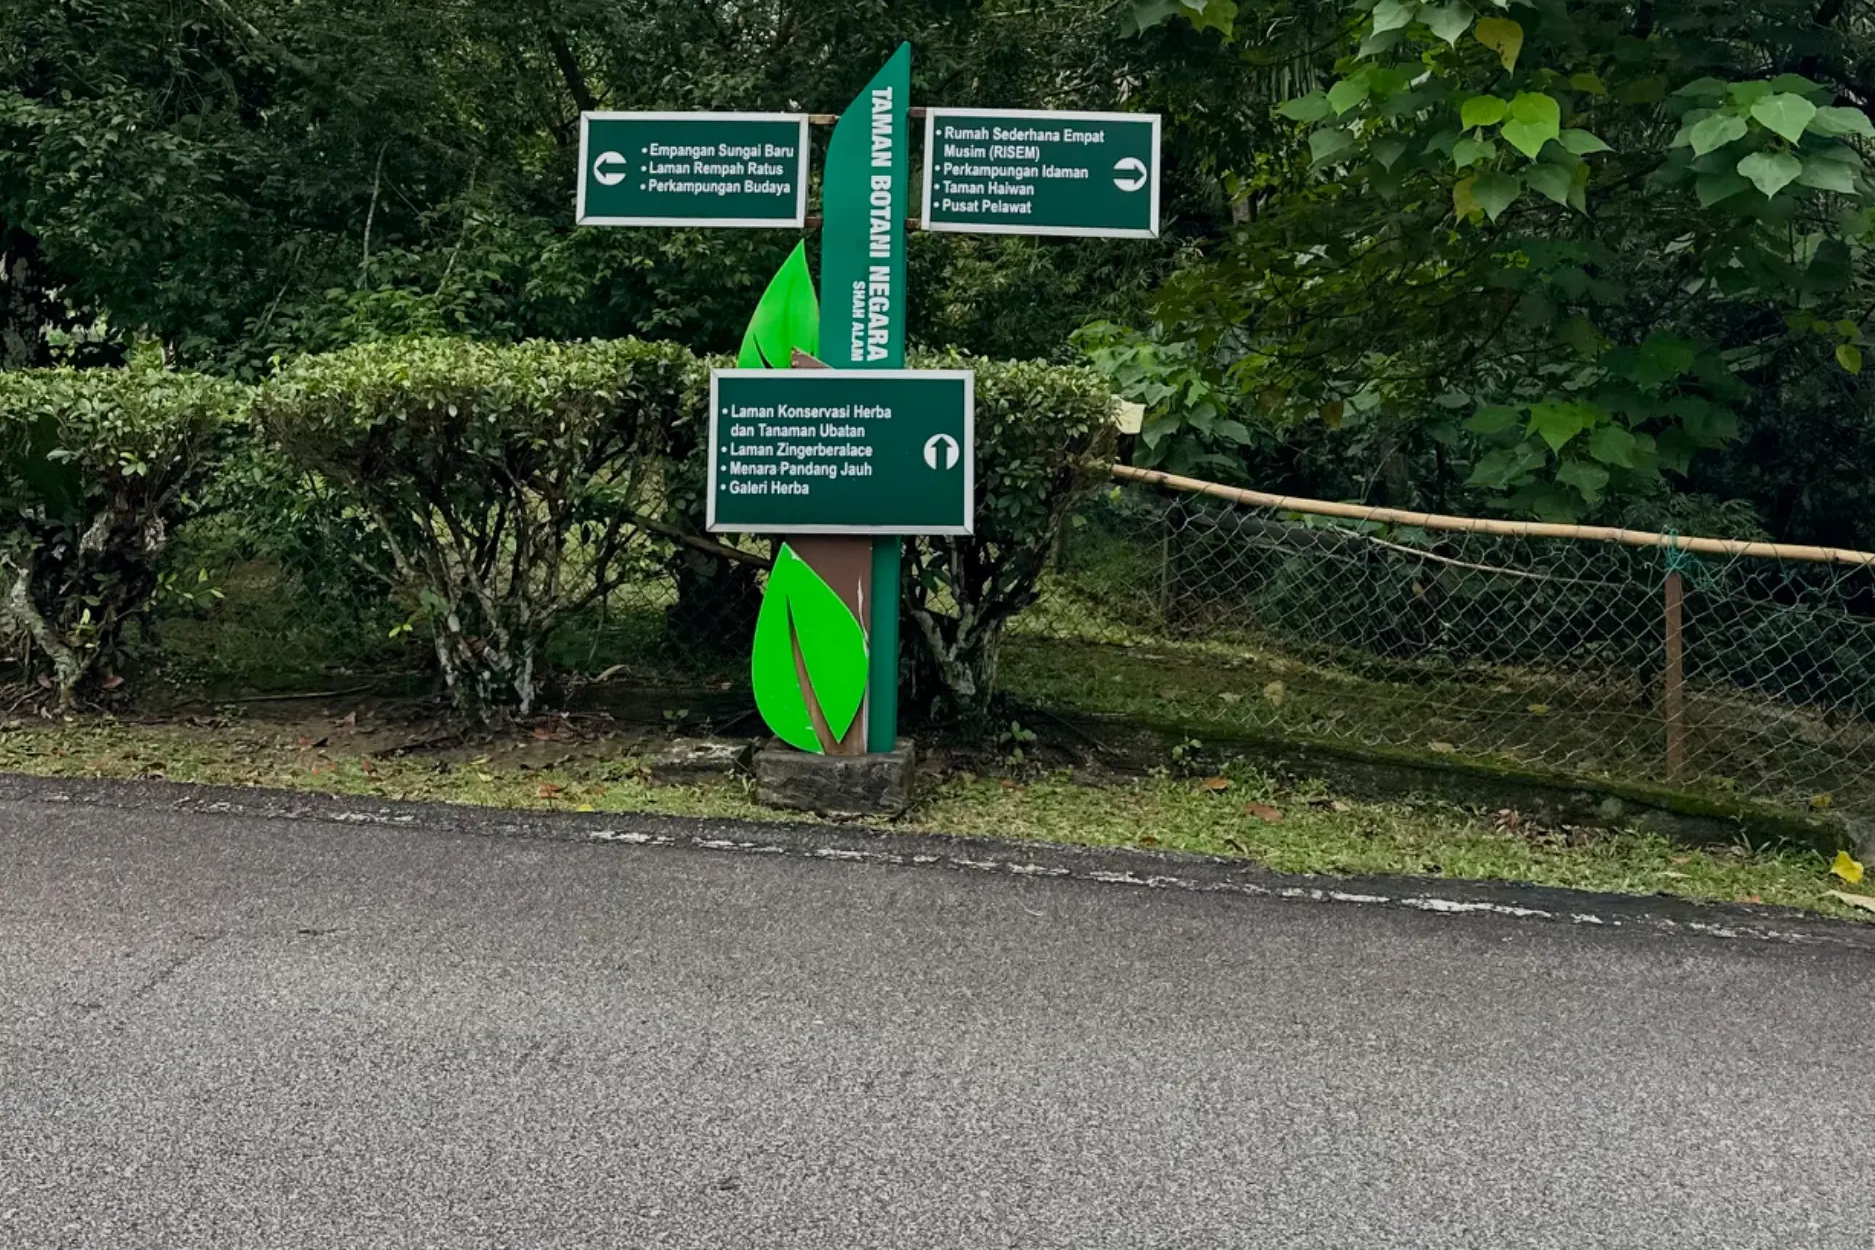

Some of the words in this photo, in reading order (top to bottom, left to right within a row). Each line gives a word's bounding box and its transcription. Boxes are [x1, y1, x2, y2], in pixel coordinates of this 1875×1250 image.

[871, 86, 893, 167] TAMAN
[944, 127, 989, 140] Rumah
[993, 128, 1059, 142] Sederhana
[1064, 129, 1104, 145] Empat
[650, 143, 715, 158] Empangan
[718, 144, 761, 160] Sungai
[765, 144, 793, 157] Baru
[944, 145, 986, 158] Musim
[989, 146, 1040, 162] (RISEM)
[649, 162, 689, 174] Laman
[694, 162, 744, 177] Rempah
[748, 163, 783, 175] Ratus
[944, 163, 1038, 180] Perkampungan
[1042, 165, 1088, 178] Idaman
[649, 179, 740, 195] Perkampungan
[745, 180, 790, 195] Budaya
[943, 181, 984, 194] Taman
[988, 182, 1034, 195] Haiwan
[942, 199, 979, 212] Pusat
[982, 200, 1031, 214] Pelawat
[870, 175, 892, 258] BOTANI
[852, 281, 865, 318] SHAH
[866, 266, 890, 361] NEGARA
[851, 321, 864, 361] ALAM
[731, 405, 774, 418] Laman
[778, 405, 850, 418] Konservasi
[854, 405, 892, 419] Herba
[731, 424, 754, 436] dan
[759, 424, 816, 437] Tanaman
[820, 424, 865, 437] Ubatan
[731, 442, 773, 455] Laman
[730, 462, 777, 475] Menara
[780, 462, 837, 478] Pandang
[841, 462, 872, 476] Jauh
[730, 481, 767, 494] Galeri
[771, 481, 809, 494] Herba
